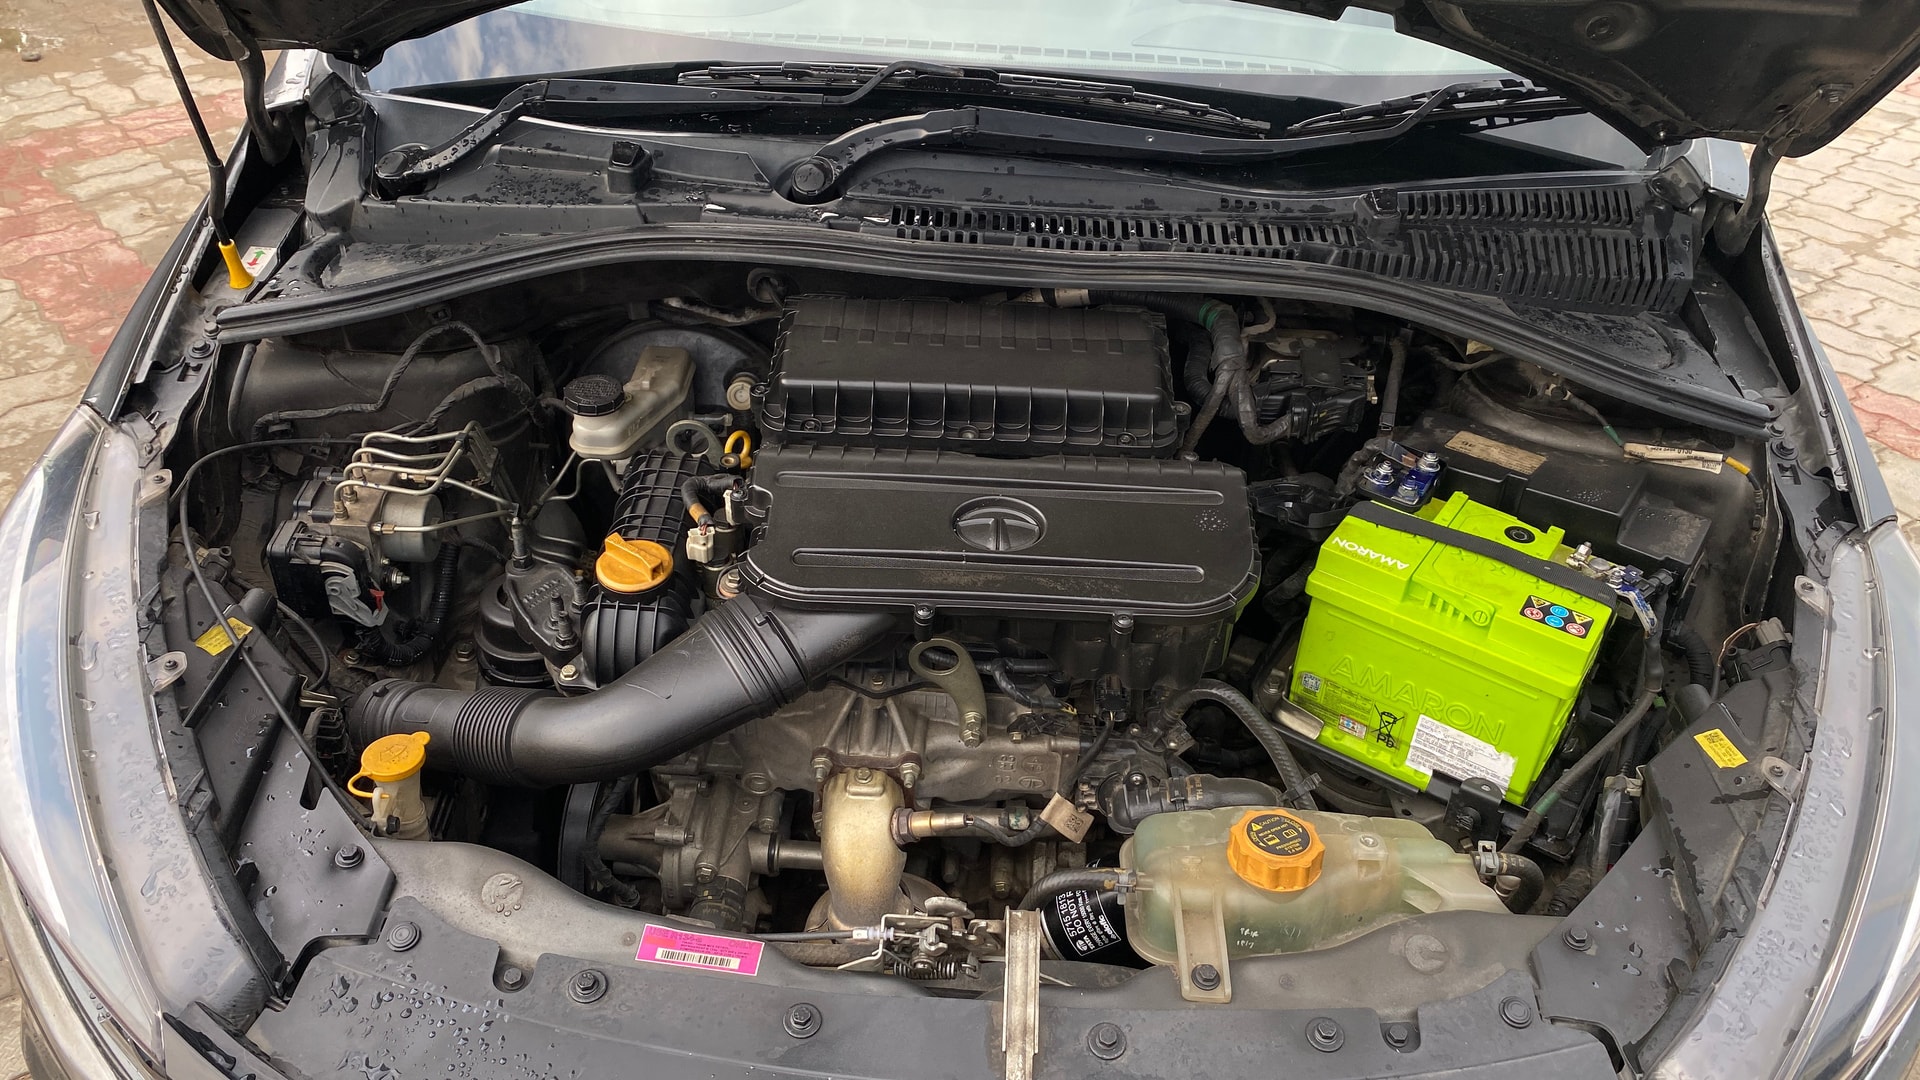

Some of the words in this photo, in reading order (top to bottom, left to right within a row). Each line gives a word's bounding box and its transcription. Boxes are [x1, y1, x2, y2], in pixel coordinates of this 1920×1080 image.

[1332, 536, 1409, 570] AMARON
[1330, 654, 1507, 745] AMARON
[1376, 732, 1395, 749] Pb
[1259, 816, 1280, 827] CAUTION
[1058, 893, 1068, 914] 1813
[1067, 898, 1078, 918] NOT
[649, 927, 668, 938] USE
[1062, 915, 1077, 937] 5715
[1073, 918, 1086, 934] DO
[1083, 935, 1095, 950] TATA
